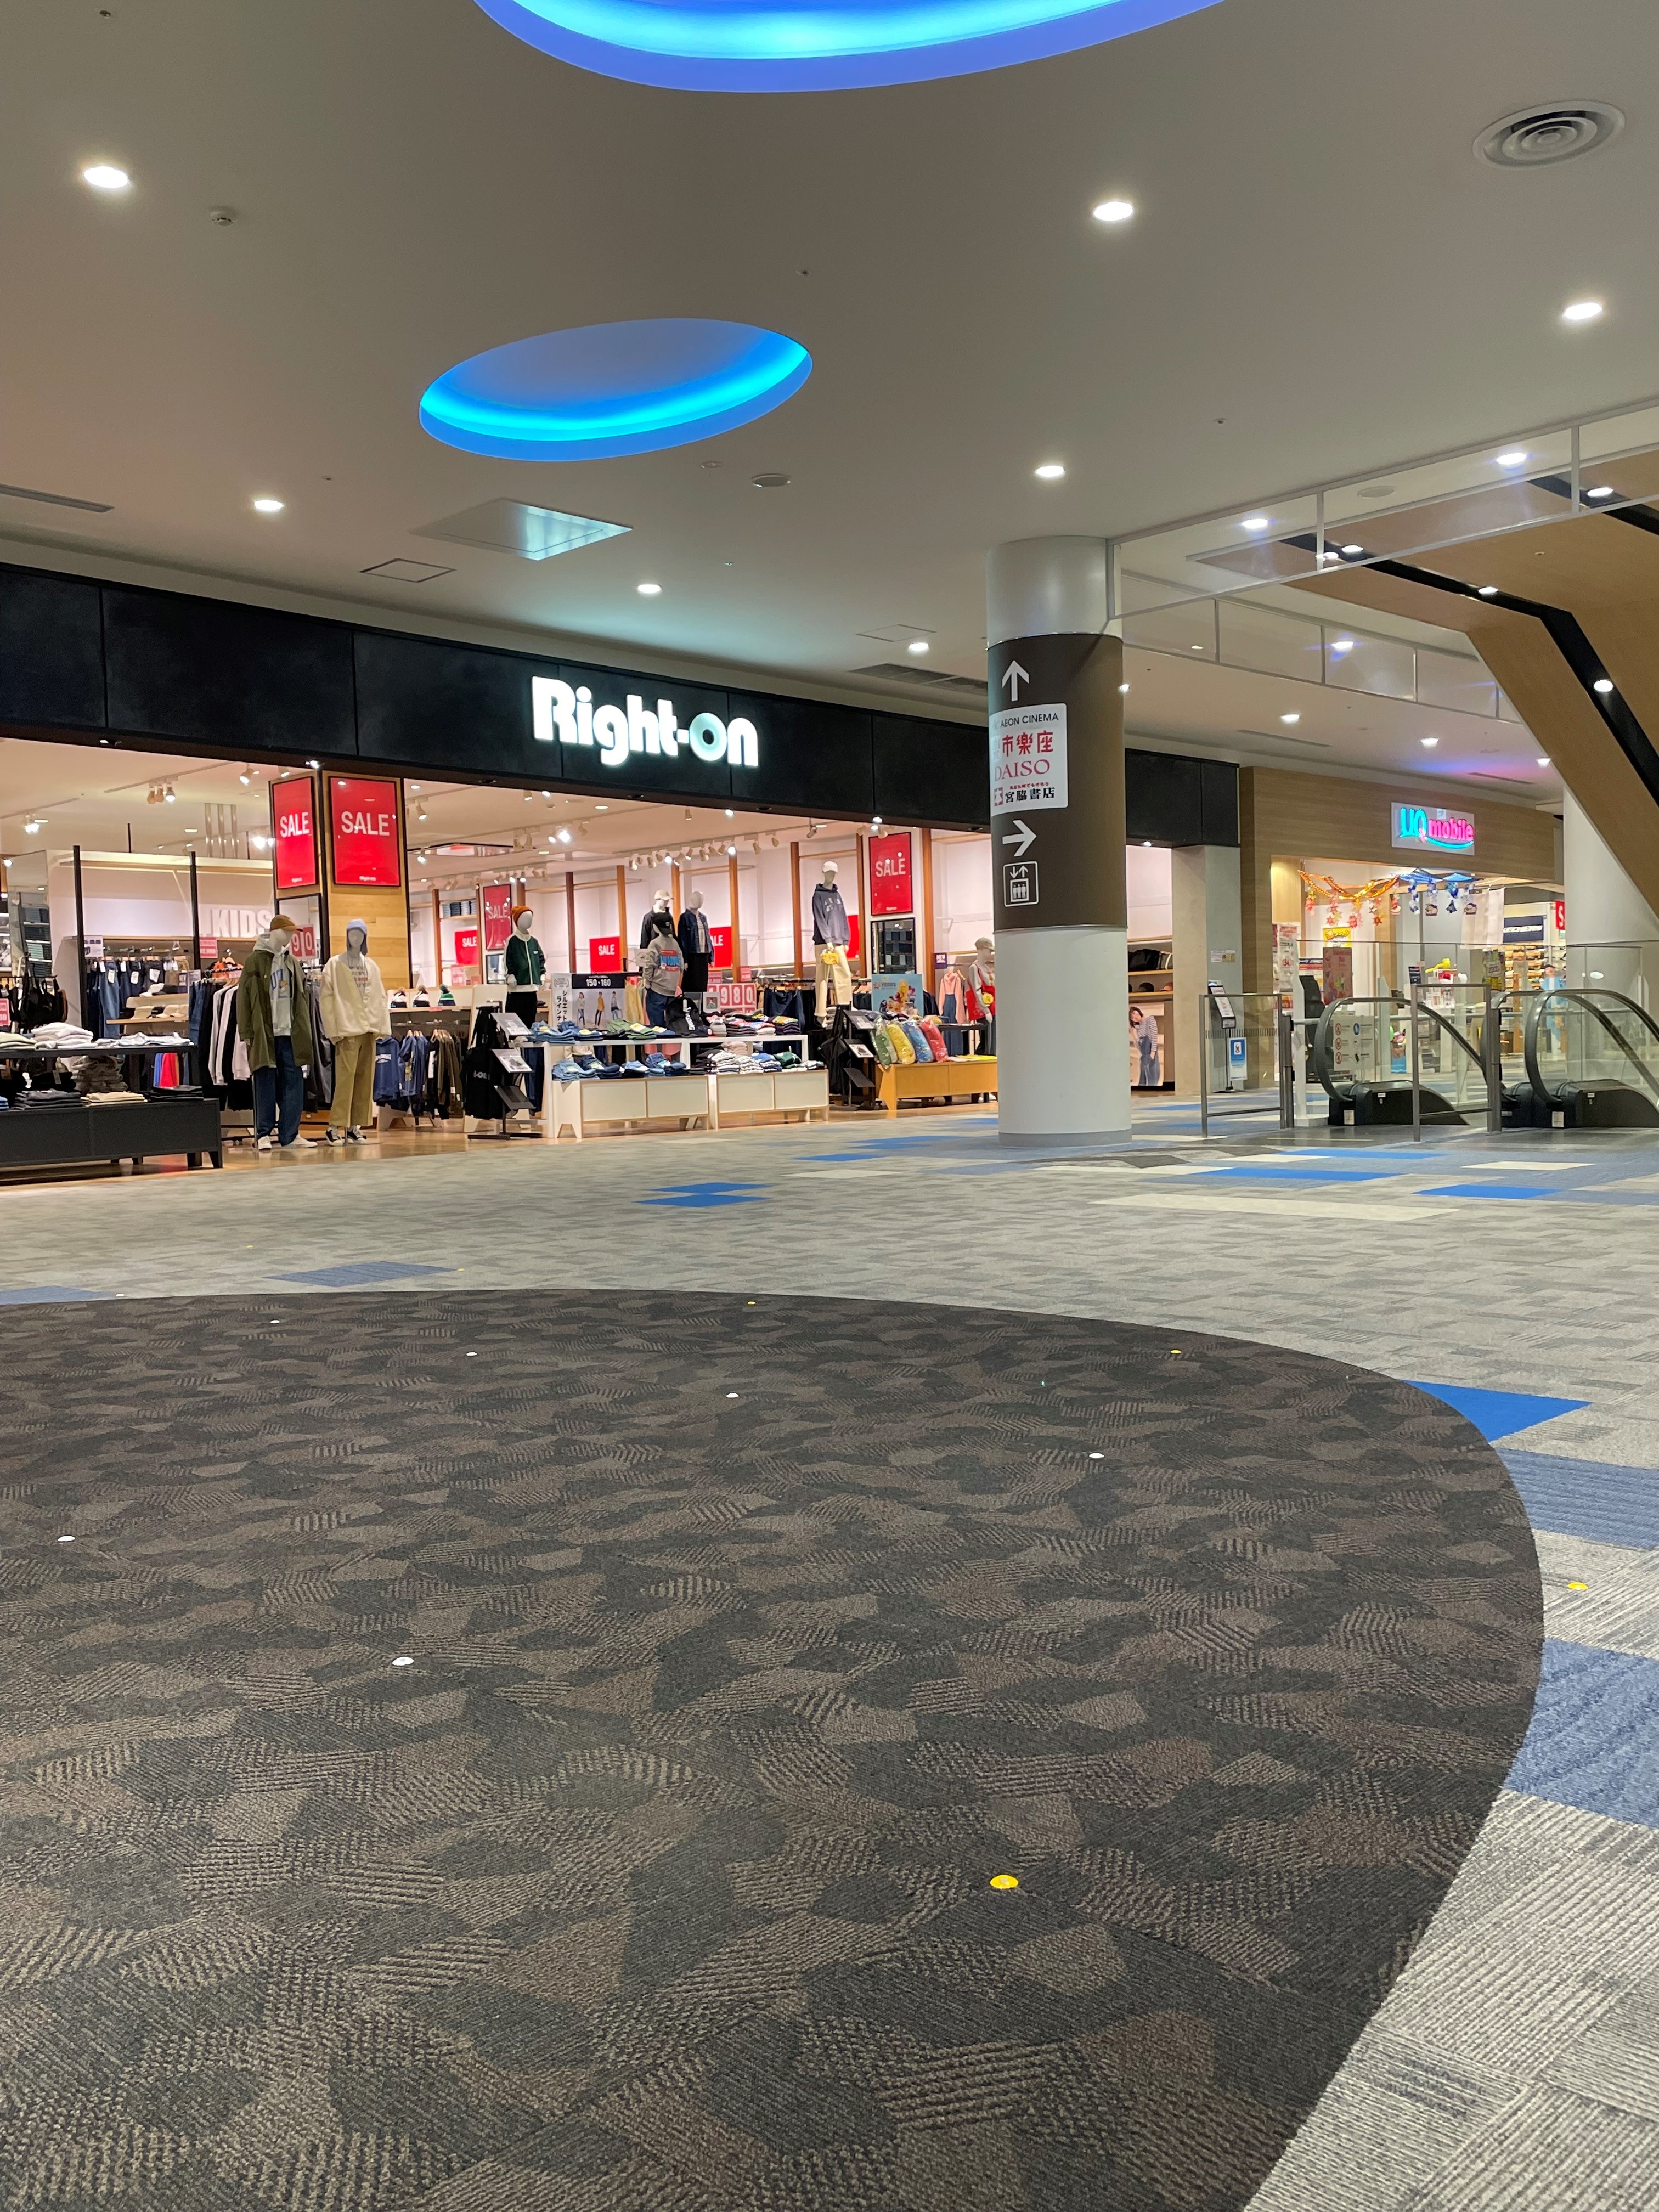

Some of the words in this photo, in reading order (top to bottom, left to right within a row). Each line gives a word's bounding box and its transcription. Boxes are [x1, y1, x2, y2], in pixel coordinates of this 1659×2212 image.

[532, 676, 759, 767] Right-on
[1000, 716, 1019, 729] AEON
[1022, 713, 1059, 724] CINEMA
[994, 759, 1050, 781] DAISO
[1005, 787, 1056, 803] 宮脇書店
[280, 811, 310, 838] SALE
[341, 811, 390, 836] SALE
[1400, 807, 1427, 842] UQ
[1429, 817, 1475, 841] mobile
[875, 858, 906, 878] SALE
[488, 905, 509, 920] SALE
[212, 909, 272, 938] KIDS
[462, 936, 477, 948] SALE
[598, 944, 615, 956] SALE
[709, 986, 753, 1004] 980
